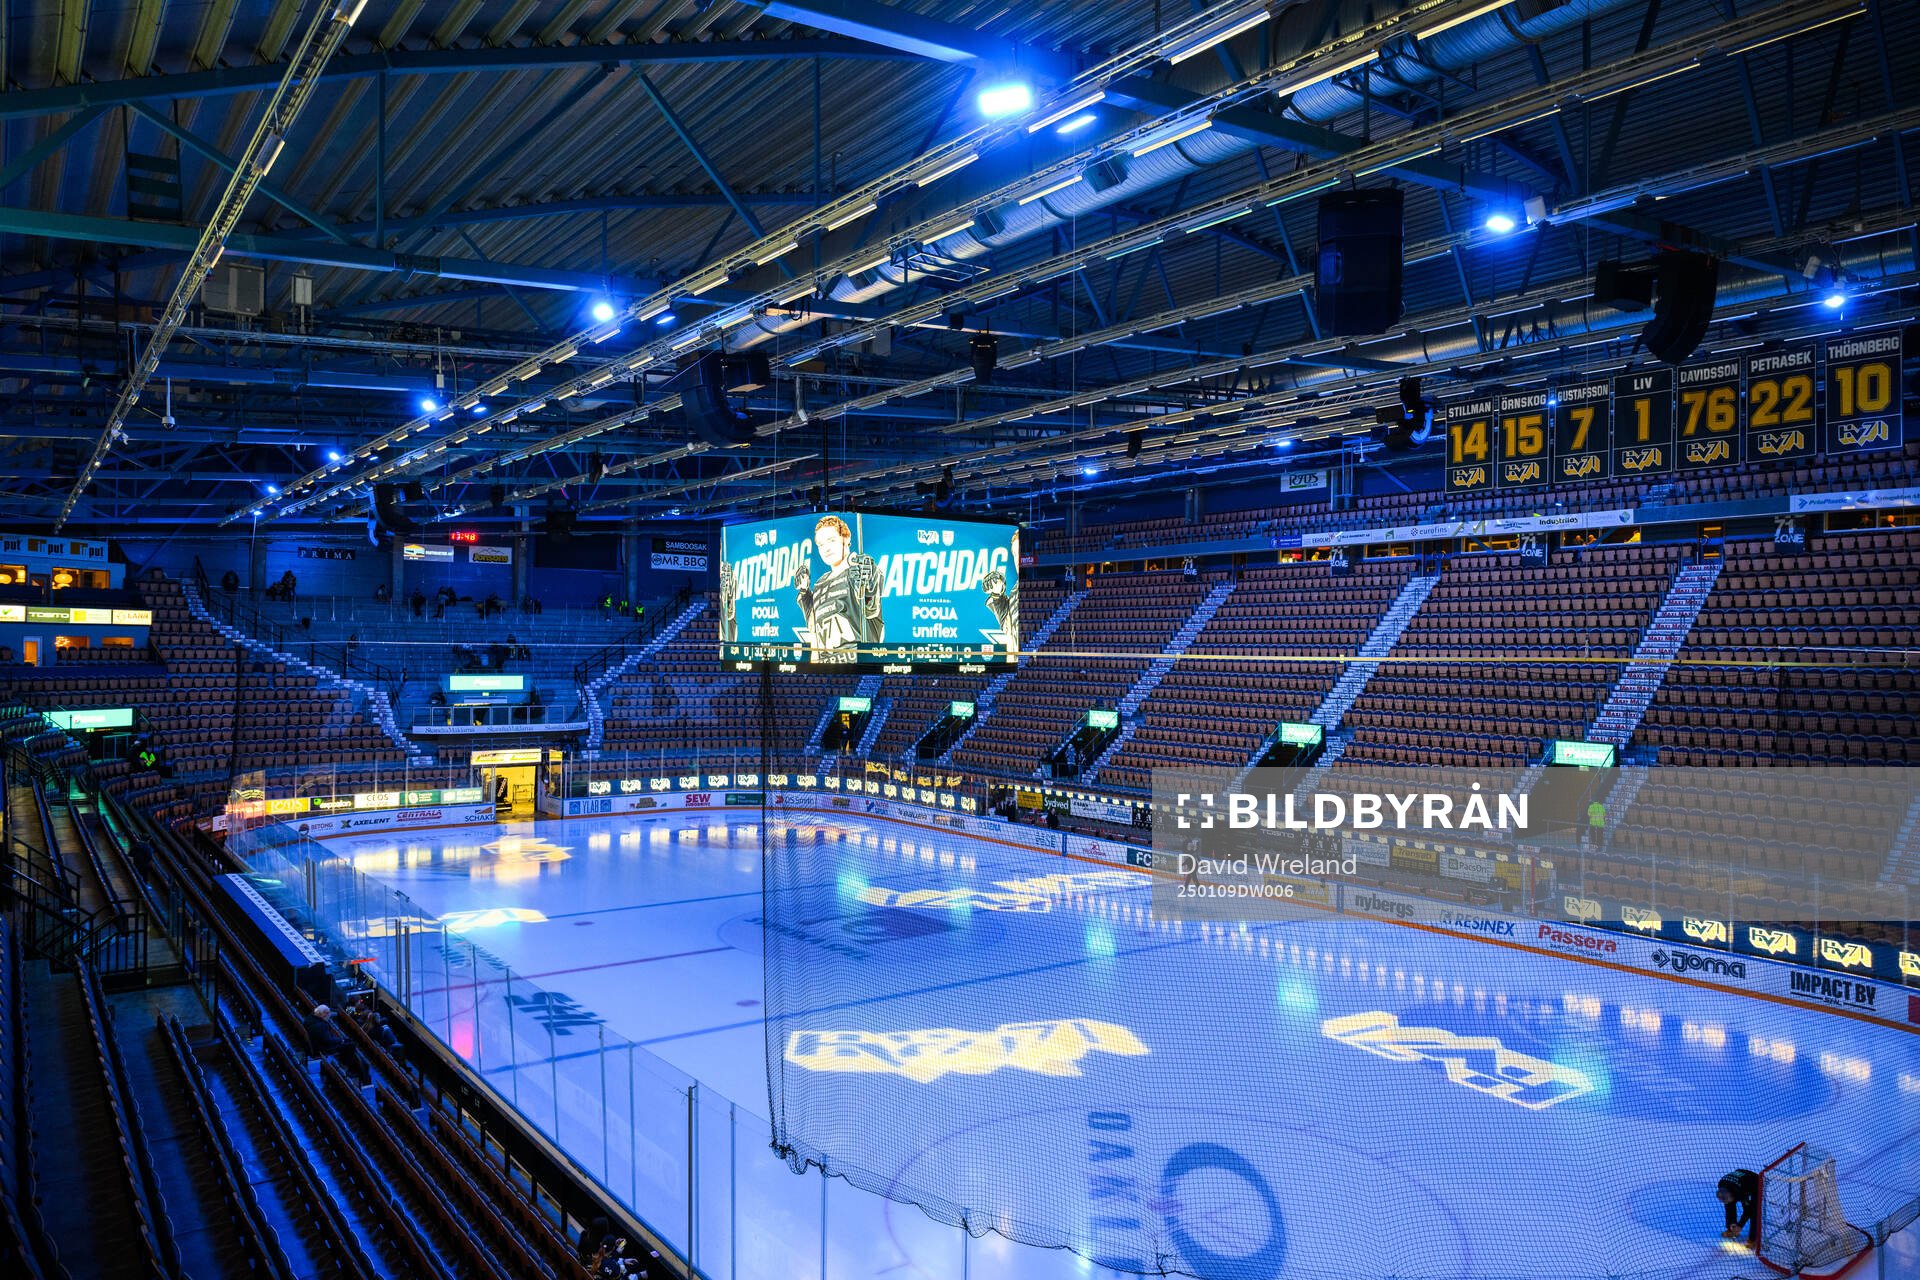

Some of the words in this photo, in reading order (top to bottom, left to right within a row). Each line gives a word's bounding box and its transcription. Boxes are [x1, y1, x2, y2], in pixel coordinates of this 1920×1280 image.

[1828, 337, 1899, 359] THÖRNBERG
[1751, 351, 1812, 373] PETRASEK
[1680, 363, 1738, 383] DAVIDSSON
[1557, 384, 1608, 402] GUSTAFSSON
[1634, 377, 1652, 390] LIV
[1835, 362, 1891, 416] 10
[1448, 402, 1491, 417] STILLMAN
[1502, 394, 1546, 411] ÖRNSKOG
[1751, 374, 1813, 427] 22
[1634, 399, 1650, 442] 1
[1682, 386, 1736, 436] 76
[1503, 414, 1543, 458] 15
[1570, 407, 1595, 450] 7
[1451, 421, 1488, 463] 14
[1419, 526, 1448, 535] eurofins
[1774, 519, 1794, 534] 71
[1521, 536, 1537, 549] 71
[1774, 534, 1804, 543] ZONE
[300, 550, 353, 560] PRIMA
[662, 555, 682, 566] MR.
[684, 556, 707, 567] BBQ
[1522, 549, 1543, 557] ZONE
[752, 606, 780, 620] POOLIA
[912, 605, 958, 620] POOLIA
[752, 622, 780, 637] uniflex
[912, 623, 958, 638] uniflex
[685, 794, 711, 803] SEW
[353, 817, 391, 826] AXELENT
[1354, 893, 1415, 918] nybergs
[1454, 912, 1515, 937] RESINEX
[1683, 915, 1726, 942] HV71
[1538, 924, 1617, 953] Passera
[1749, 926, 1796, 955] HV71
[1820, 938, 1872, 968] HV71
[1790, 970, 1852, 1001] IMPACT
[1855, 983, 1877, 1005] BY
